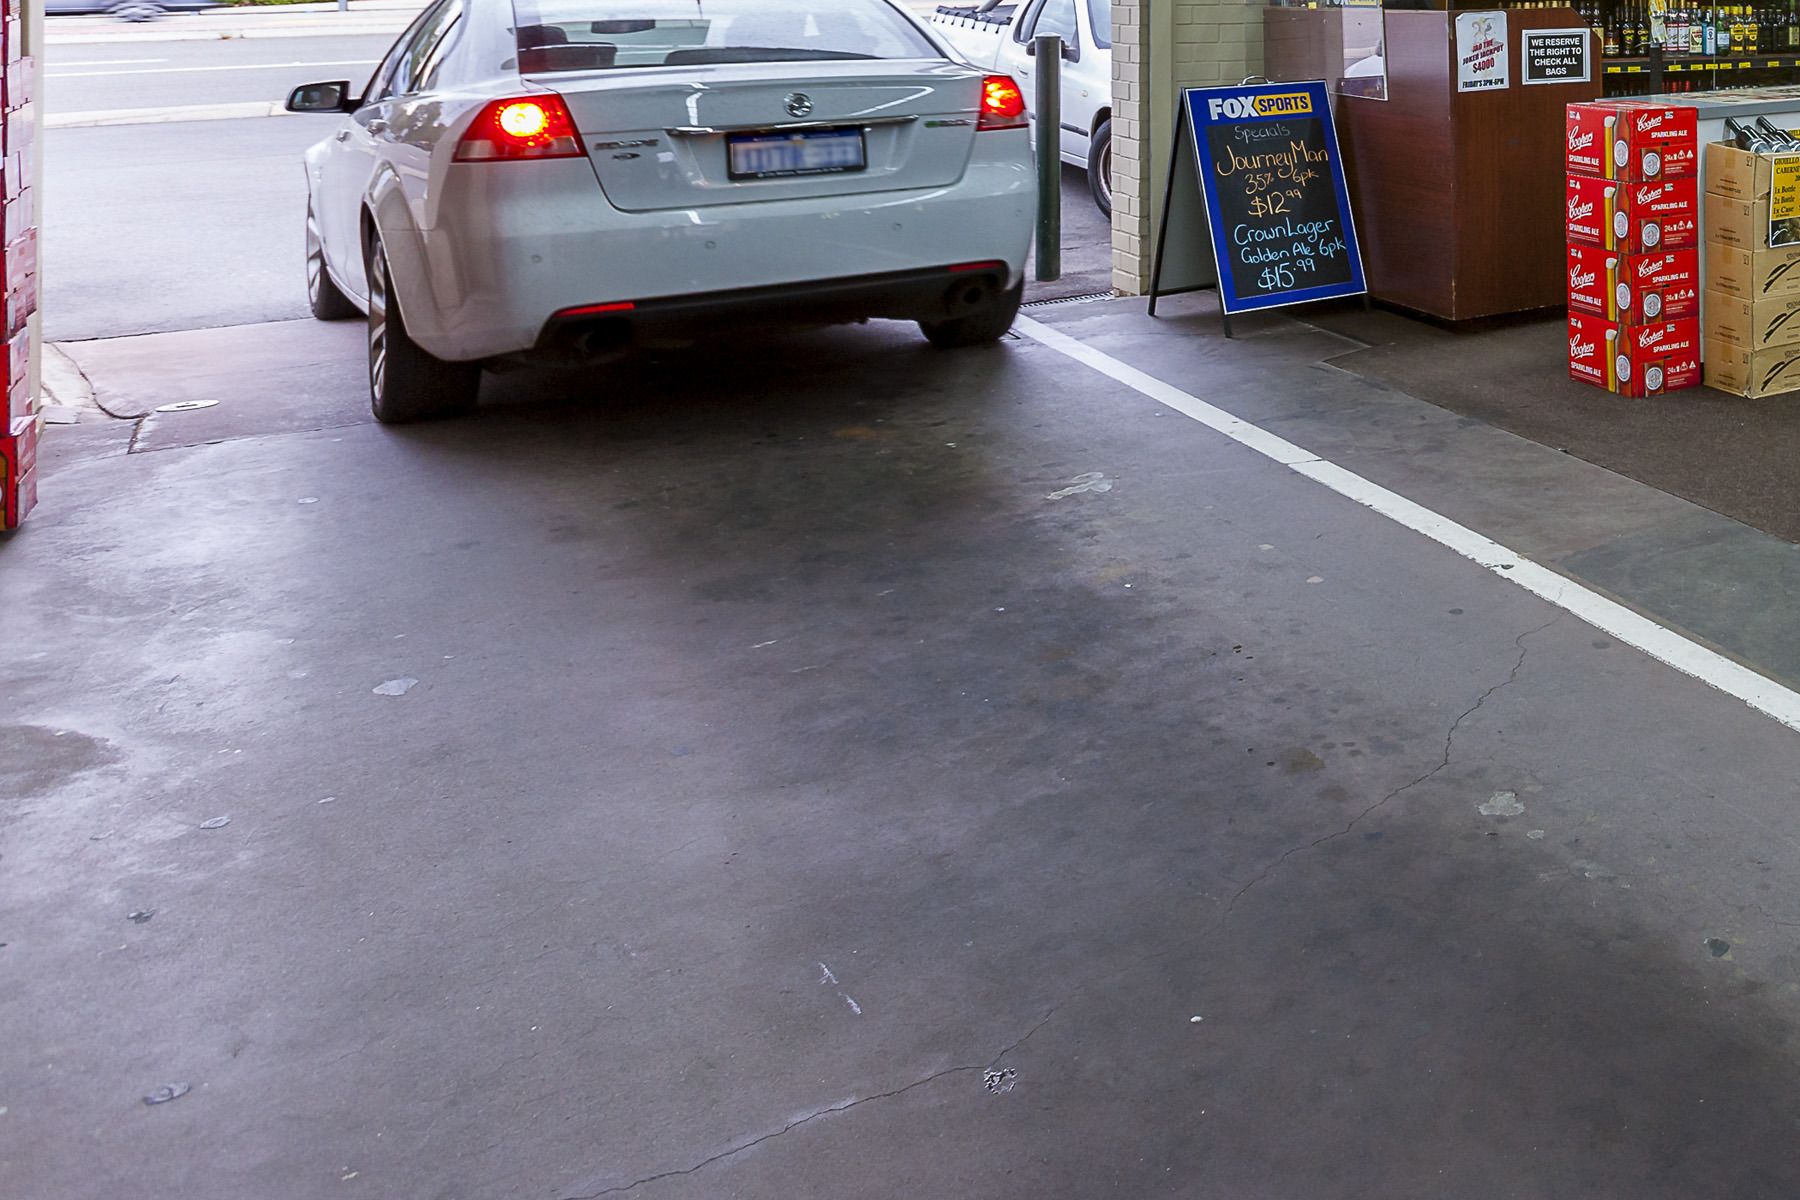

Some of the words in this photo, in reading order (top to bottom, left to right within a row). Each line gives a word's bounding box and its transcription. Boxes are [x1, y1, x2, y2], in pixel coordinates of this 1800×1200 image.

[1545, 38, 1580, 46] RESERVE
[1480, 43, 1504, 60] JACKPOT
[1473, 58, 1495, 73] $4000
[1546, 67, 1567, 75] BAGS
[1208, 95, 1259, 120] FOX
[1259, 95, 1309, 112] SPORTS
[1637, 114, 1662, 131] Coopers
[1234, 124, 1290, 144] Specials
[1568, 126, 1593, 151] Coopers
[1651, 130, 1675, 139] SPARKLING
[1676, 129, 1688, 137] ALE
[1292, 169, 1319, 187] 6pk
[1637, 185, 1662, 203] Coopers
[1241, 247, 1289, 264] Golden
[1293, 243, 1315, 257] Ale
[1319, 236, 1347, 258] 6pk
